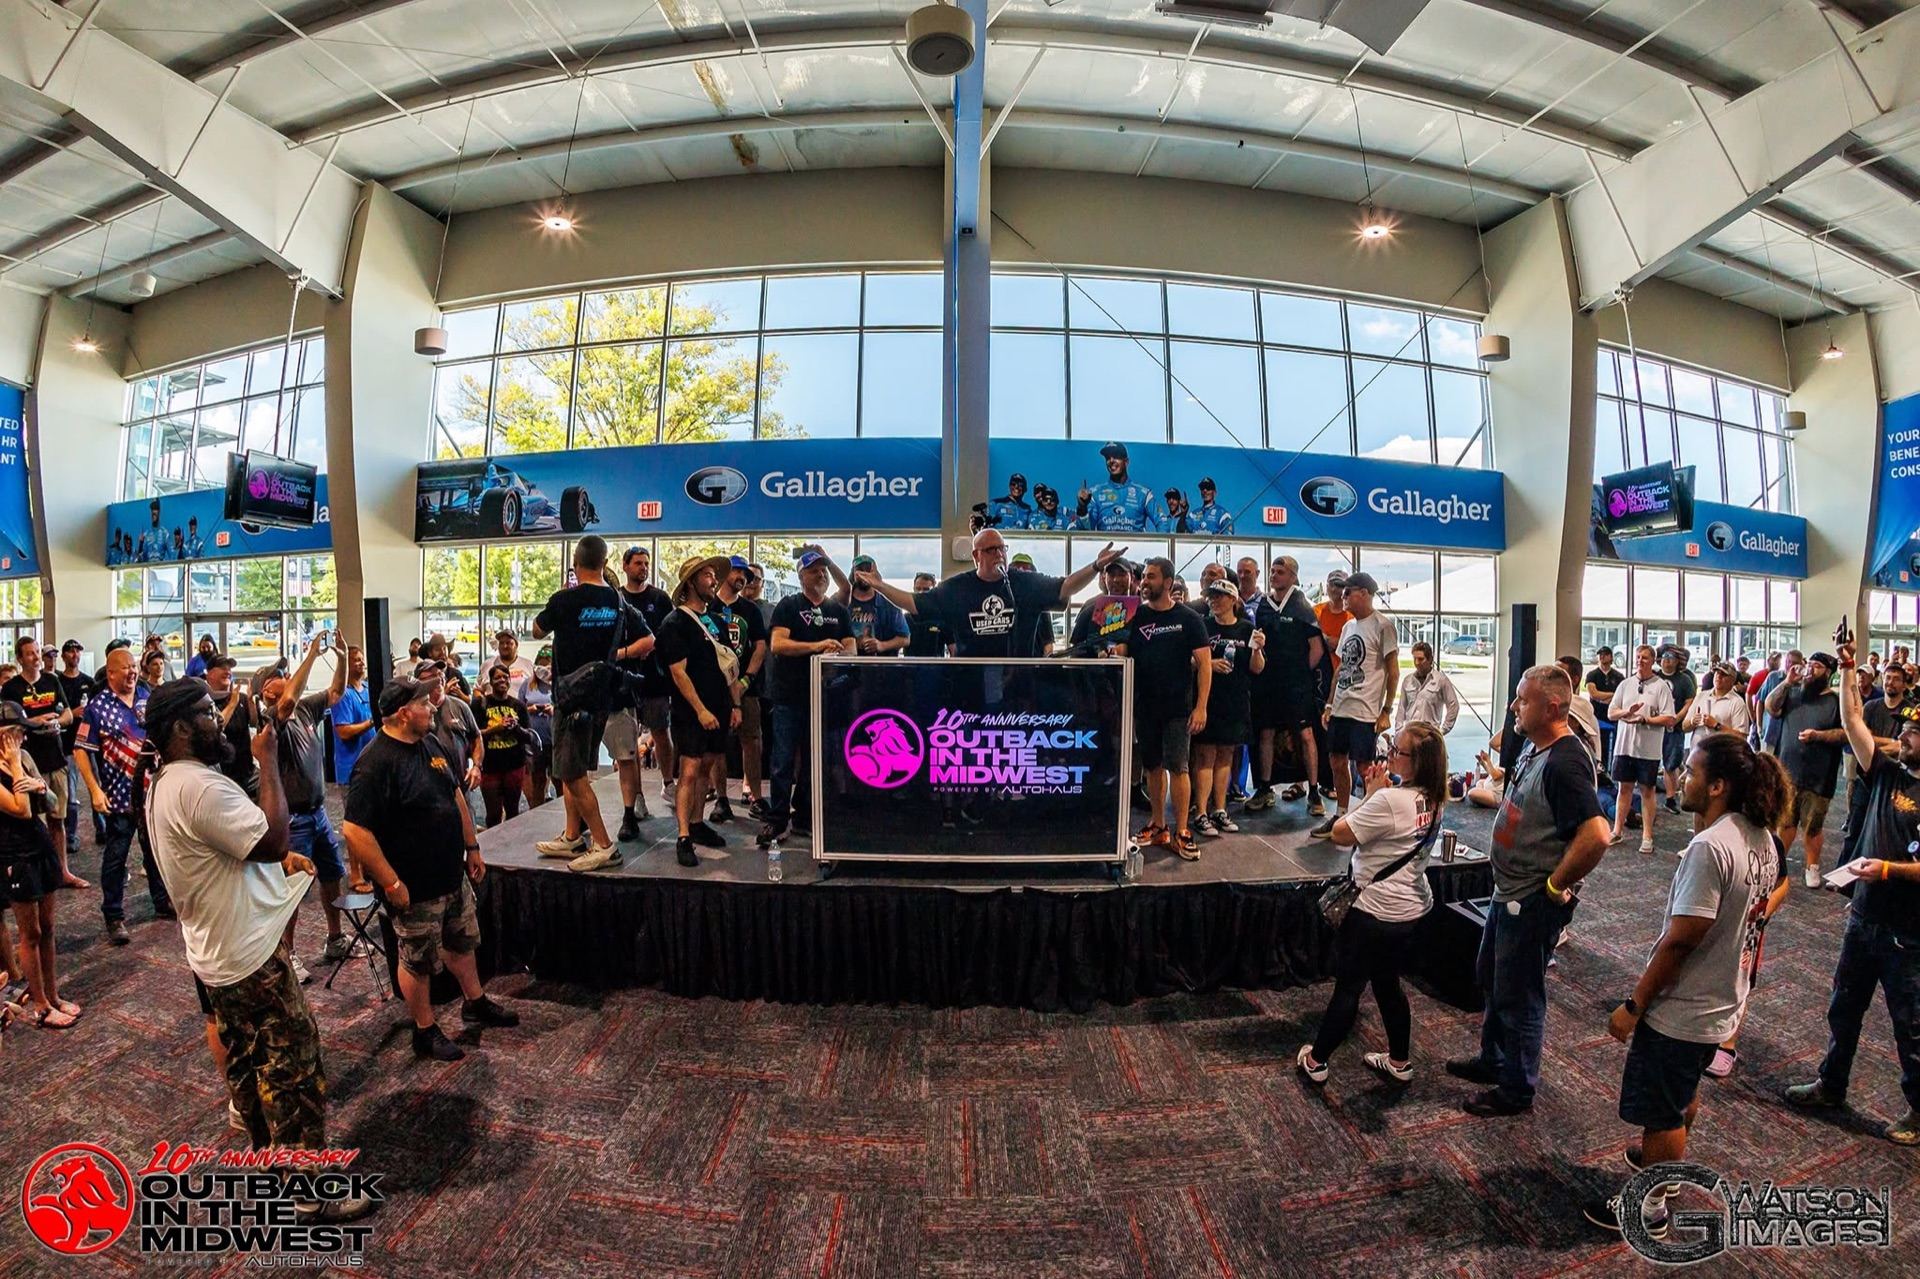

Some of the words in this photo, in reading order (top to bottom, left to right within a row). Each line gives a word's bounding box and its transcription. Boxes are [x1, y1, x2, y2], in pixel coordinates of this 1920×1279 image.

[1, 435, 17, 448] HR
[760, 471, 923, 502] Gallagher
[641, 502, 658, 517] EXIT
[1368, 488, 1491, 523] Gallagher
[1268, 509, 1284, 523] EXIT
[1740, 530, 1800, 557] Gallagher
[981, 711, 1074, 727] ANNIVERSARY
[930, 730, 1098, 749] OUTBACK
[930, 748, 963, 765] IN
[970, 748, 1037, 765] THE
[930, 766, 1090, 784] MIDWEST
[1001, 785, 1082, 794] AUTOHAUS
